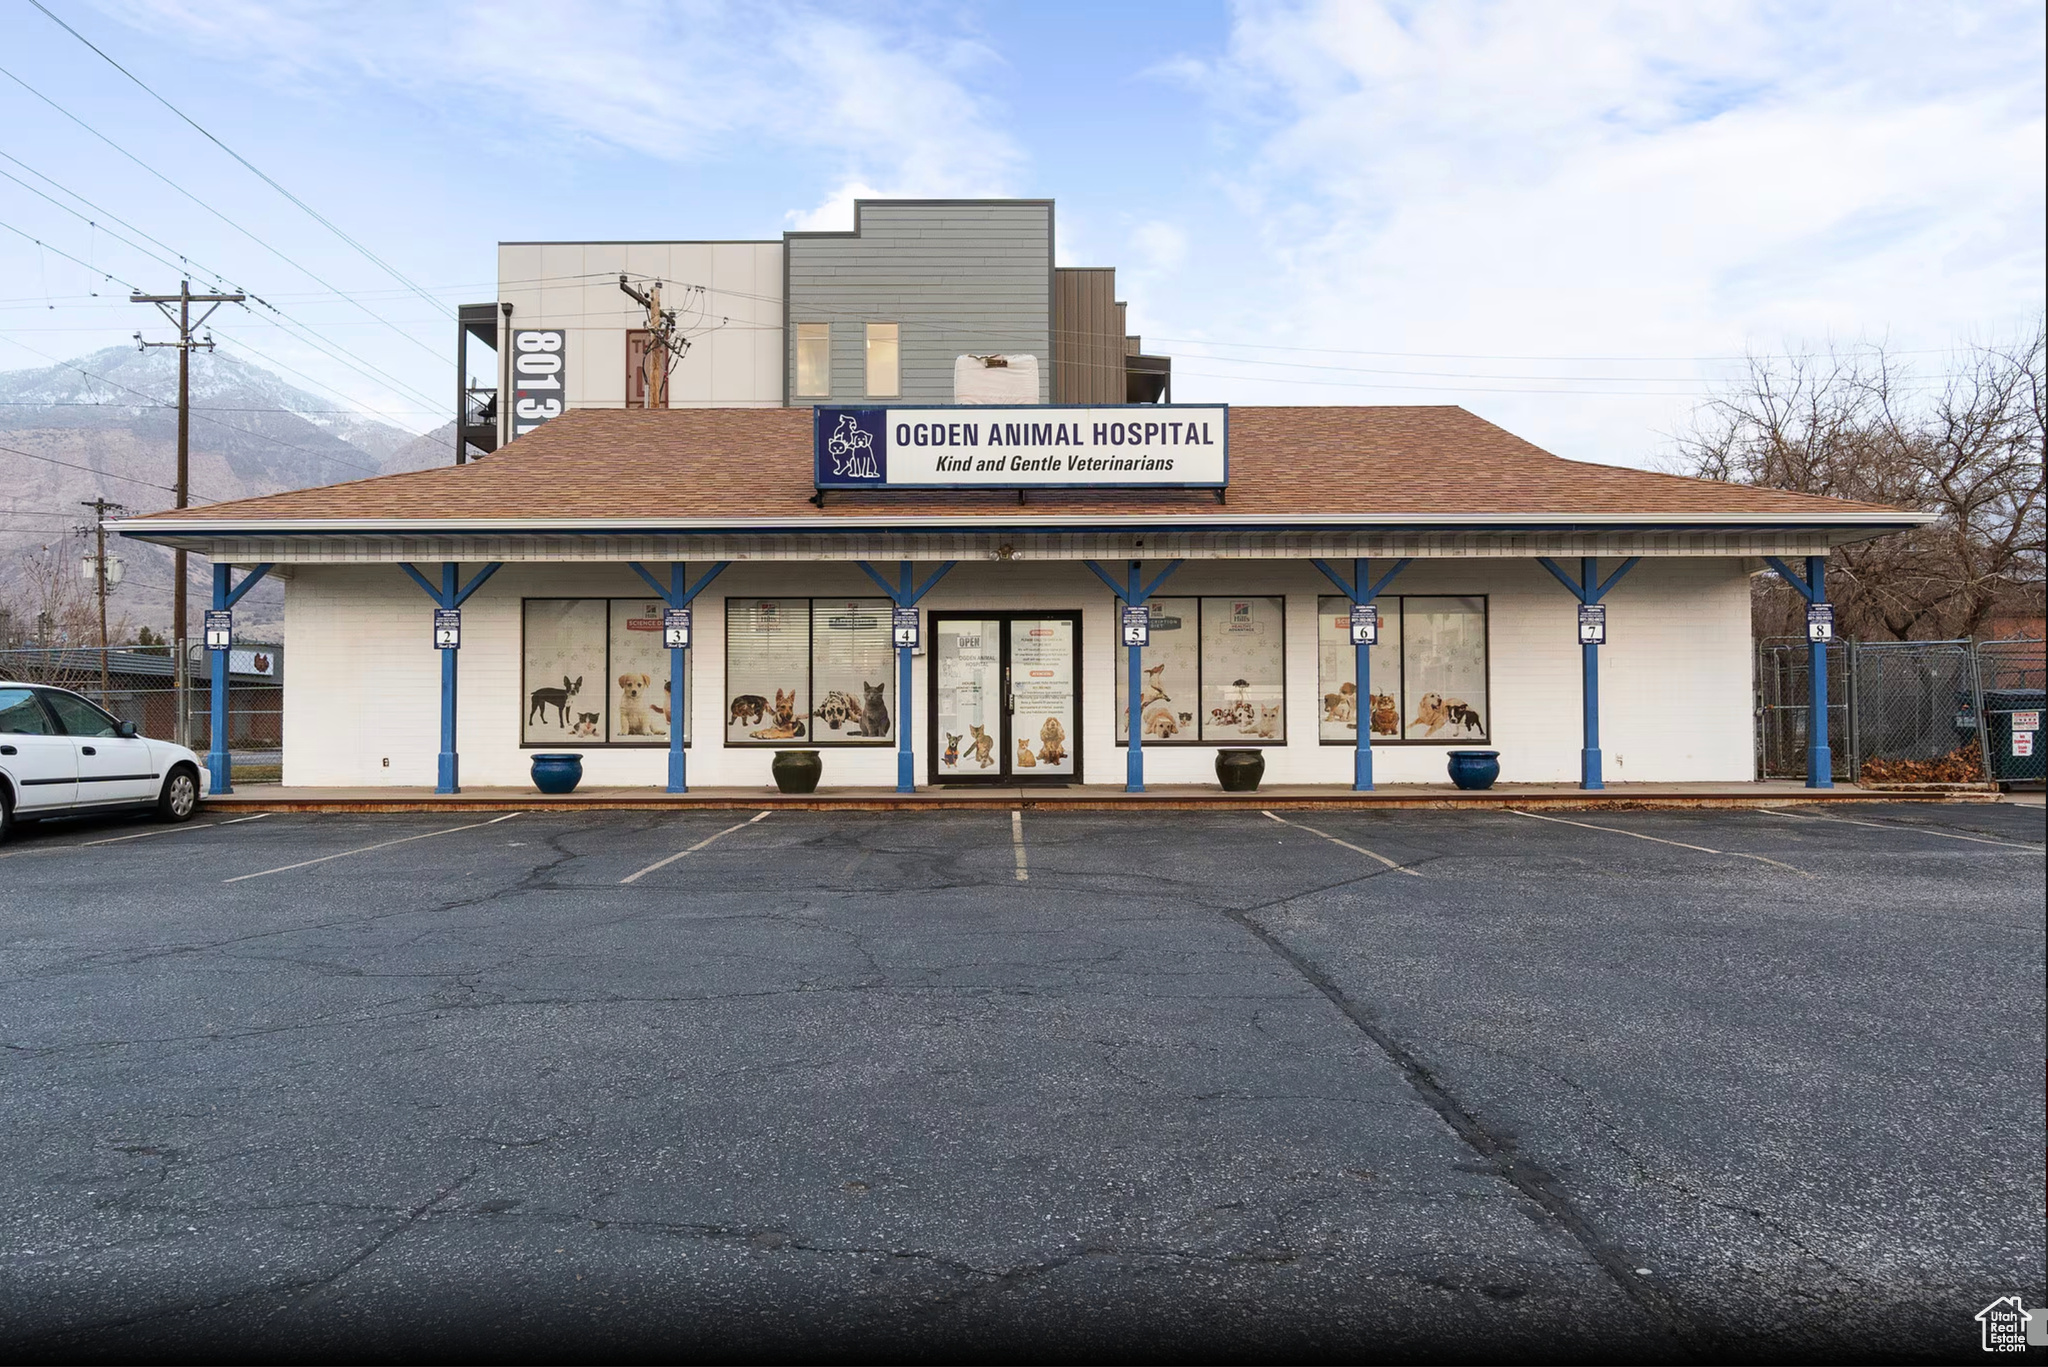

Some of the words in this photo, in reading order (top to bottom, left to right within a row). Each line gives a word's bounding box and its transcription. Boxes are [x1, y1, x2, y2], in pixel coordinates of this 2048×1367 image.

[896, 423, 979, 446] OGDEN
[987, 423, 1084, 446] ANIMAL
[1093, 422, 1214, 446] HOSPITAL
[935, 455, 973, 472] Kind
[976, 455, 1006, 472] and
[1010, 455, 1062, 472] Gentle
[1067, 455, 1174, 471] Veterinarians
[443, 630, 451, 643] 2
[673, 630, 680, 643] 3
[902, 629, 909, 641] 4
[1132, 628, 1140, 641] 5
[1360, 626, 1368, 639] 6
[1588, 626, 1596, 638] 7
[1816, 624, 1824, 637] 8
[216, 632, 220, 644] 1
[959, 637, 980, 647] OPEN
